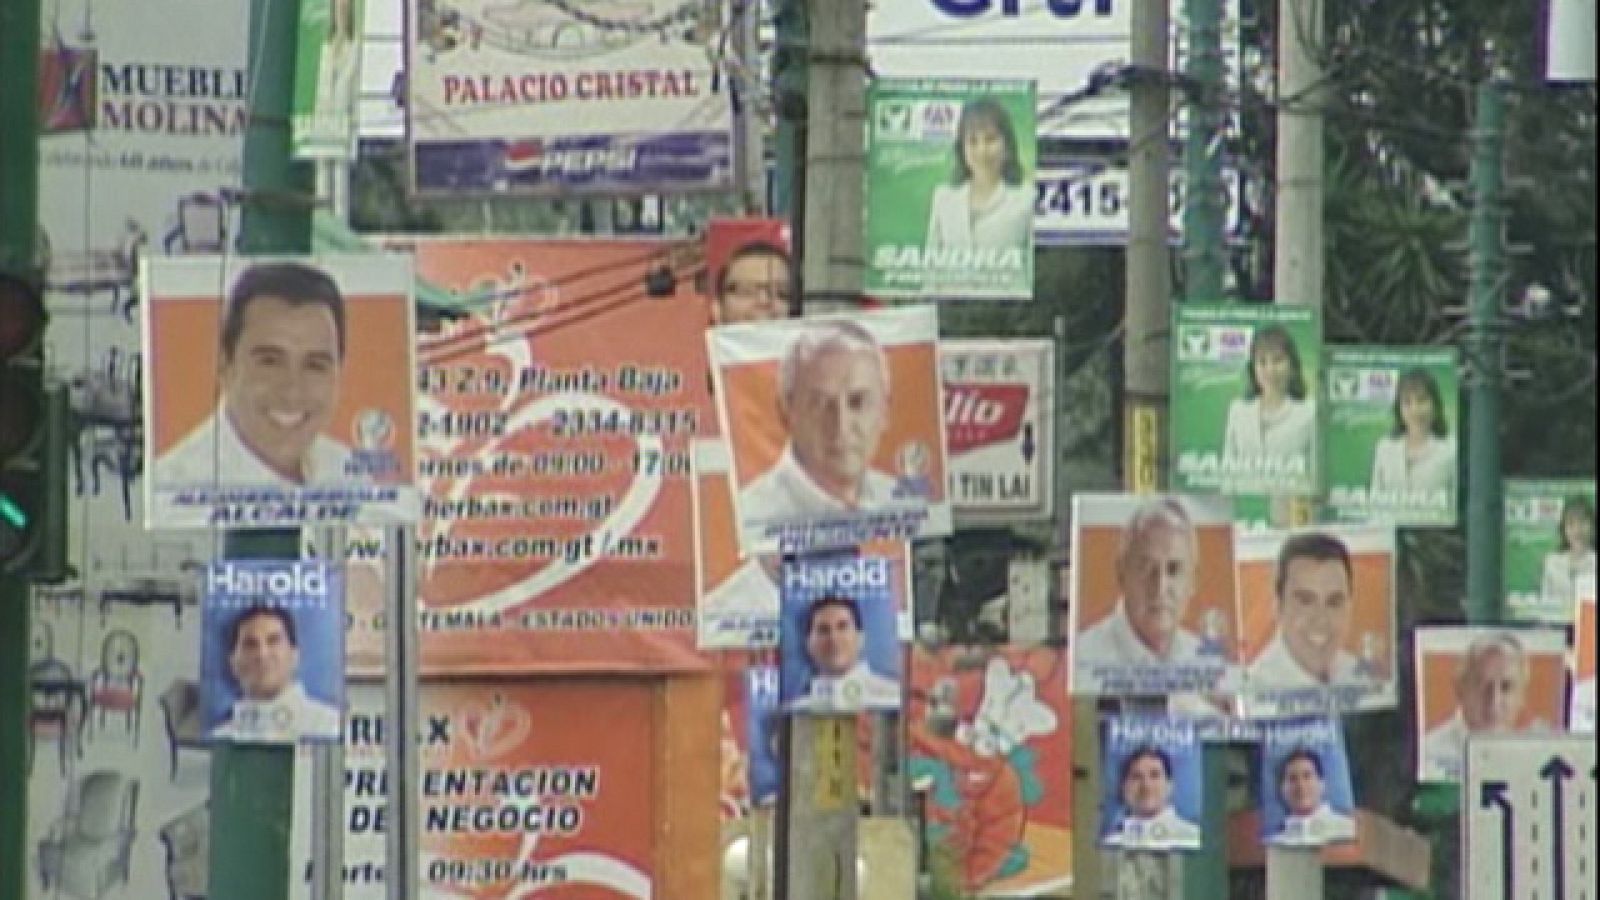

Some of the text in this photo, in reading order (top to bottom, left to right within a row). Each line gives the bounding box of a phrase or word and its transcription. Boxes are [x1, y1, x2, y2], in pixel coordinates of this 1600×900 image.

[443, 70, 699, 103] PALACIO CRISTAL
[874, 246, 1024, 270] SANDRA
[519, 366, 611, 395] Planta
[618, 364, 681, 397] Baja
[207, 563, 327, 596] Harold
[783, 557, 887, 589] Harold
[426, 806, 580, 832] NEGOCIO
[428, 860, 513, 882] 09:30
[519, 859, 567, 881] hrs
